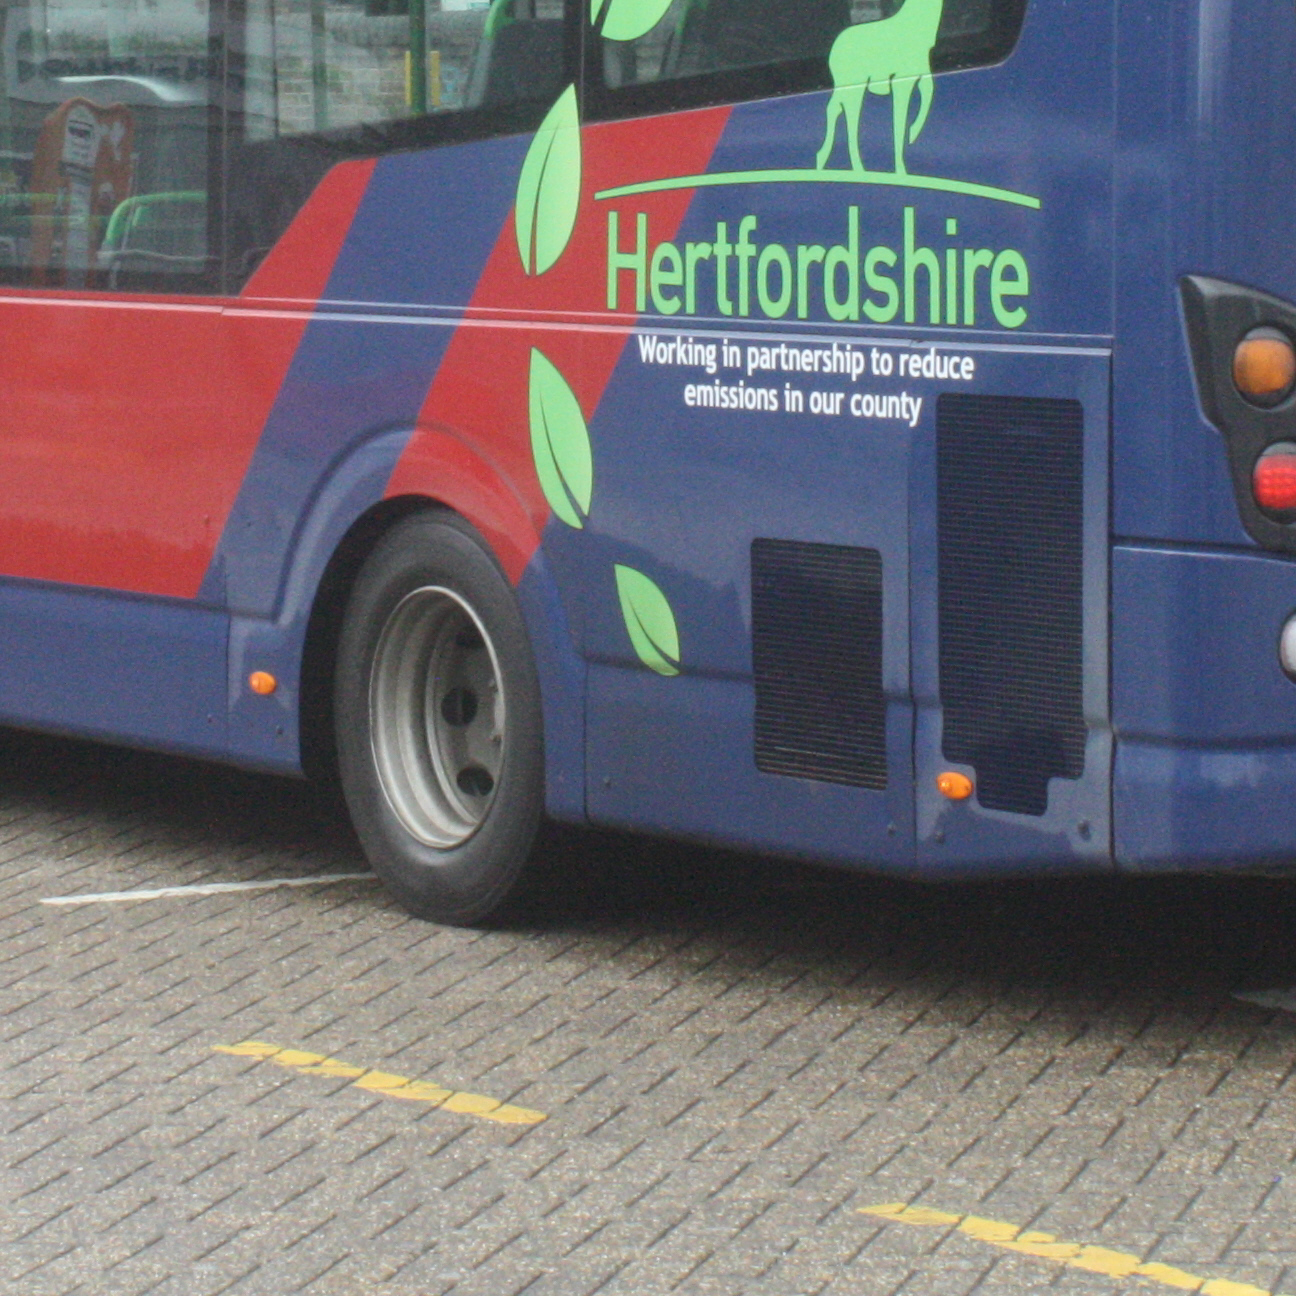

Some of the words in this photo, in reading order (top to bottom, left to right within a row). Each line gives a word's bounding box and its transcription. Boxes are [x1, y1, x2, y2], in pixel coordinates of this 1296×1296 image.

[607, 206, 1029, 329] Hertfordshire
[638, 335, 717, 374] Working
[722, 338, 741, 368] in
[747, 342, 865, 381] partnership
[871, 348, 893, 377] to
[899, 347, 975, 381] reduce
[683, 382, 779, 412] emissions
[784, 383, 803, 413] in
[809, 391, 846, 416] our
[850, 391, 923, 427] county
